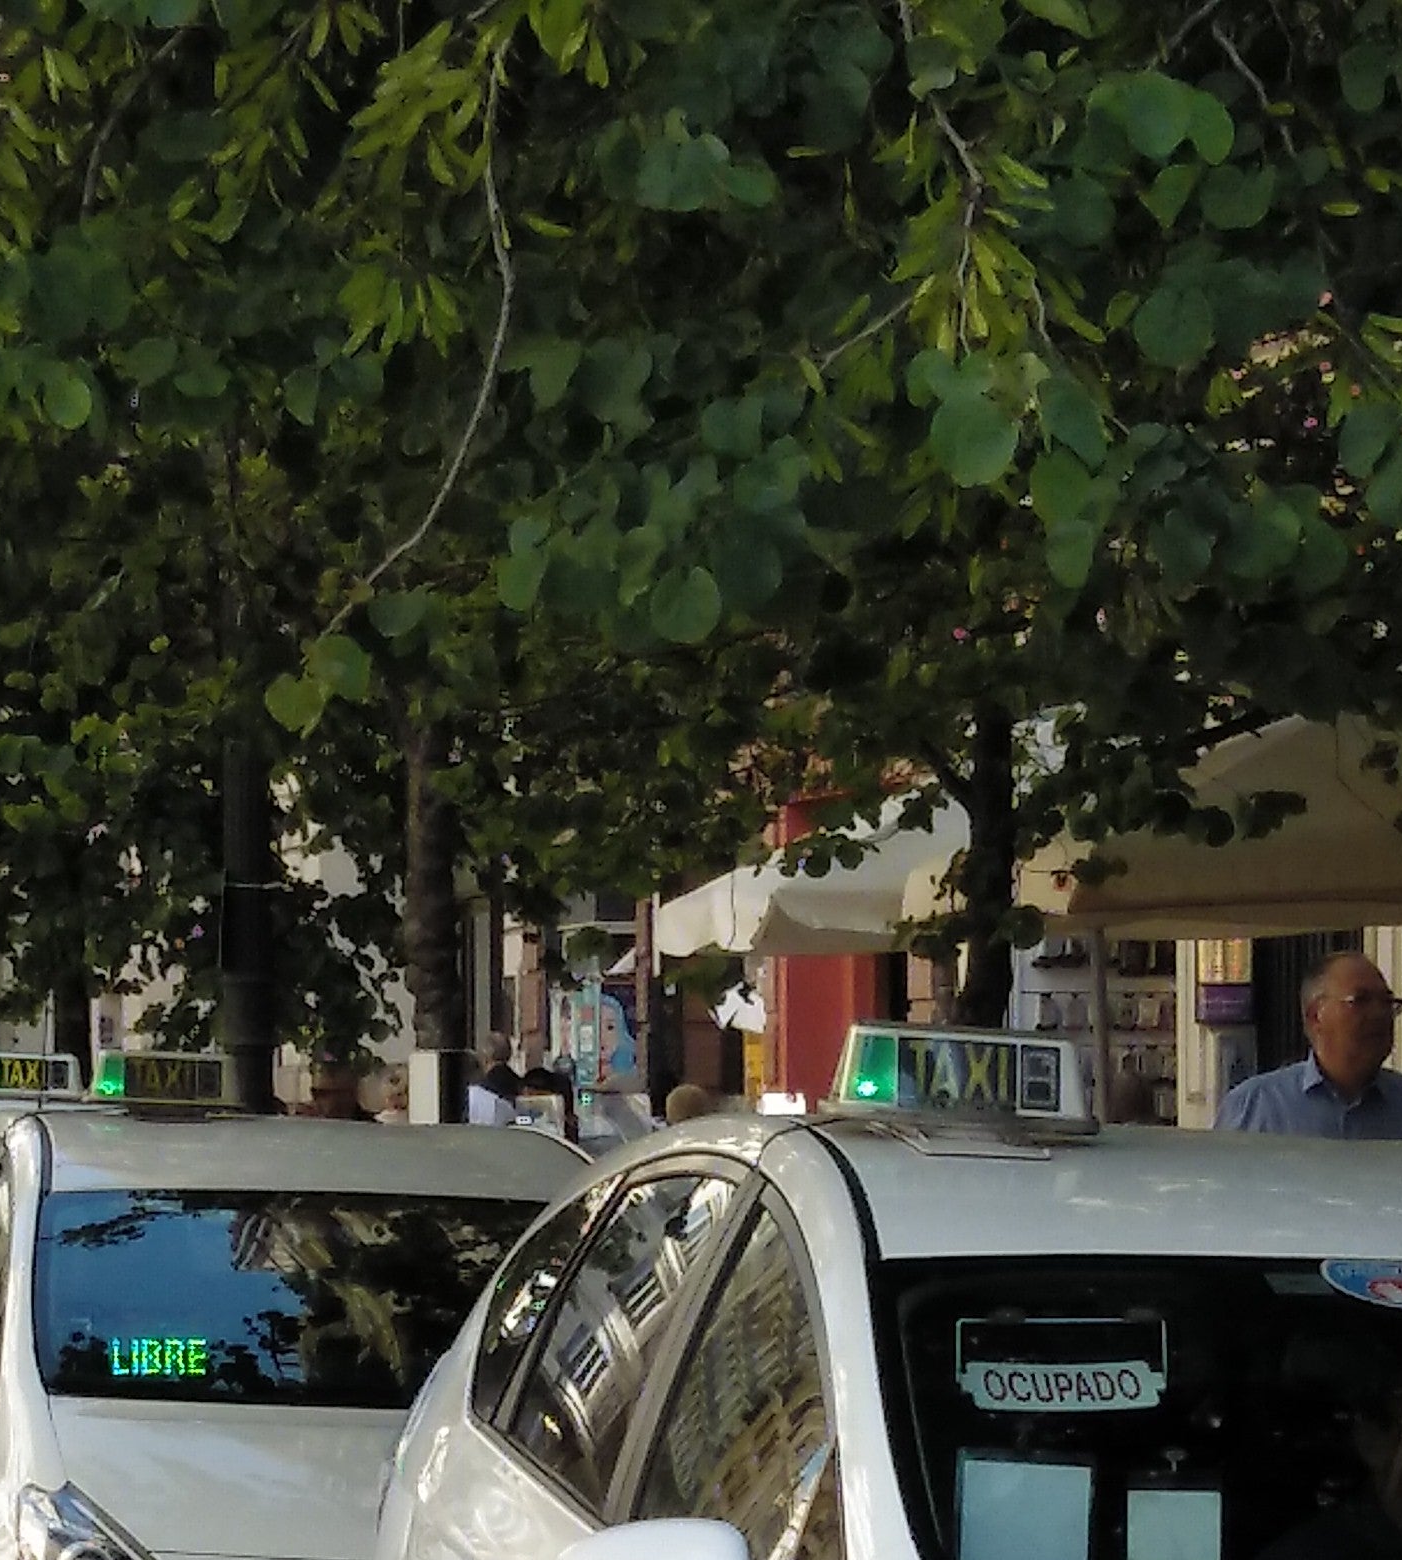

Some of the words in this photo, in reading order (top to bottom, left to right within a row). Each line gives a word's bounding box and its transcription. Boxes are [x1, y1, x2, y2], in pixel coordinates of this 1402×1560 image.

[909, 1039, 1009, 1102] TAXI
[111, 1337, 207, 1376] LIBRE
[983, 1368, 1142, 1403] OCUPADO
